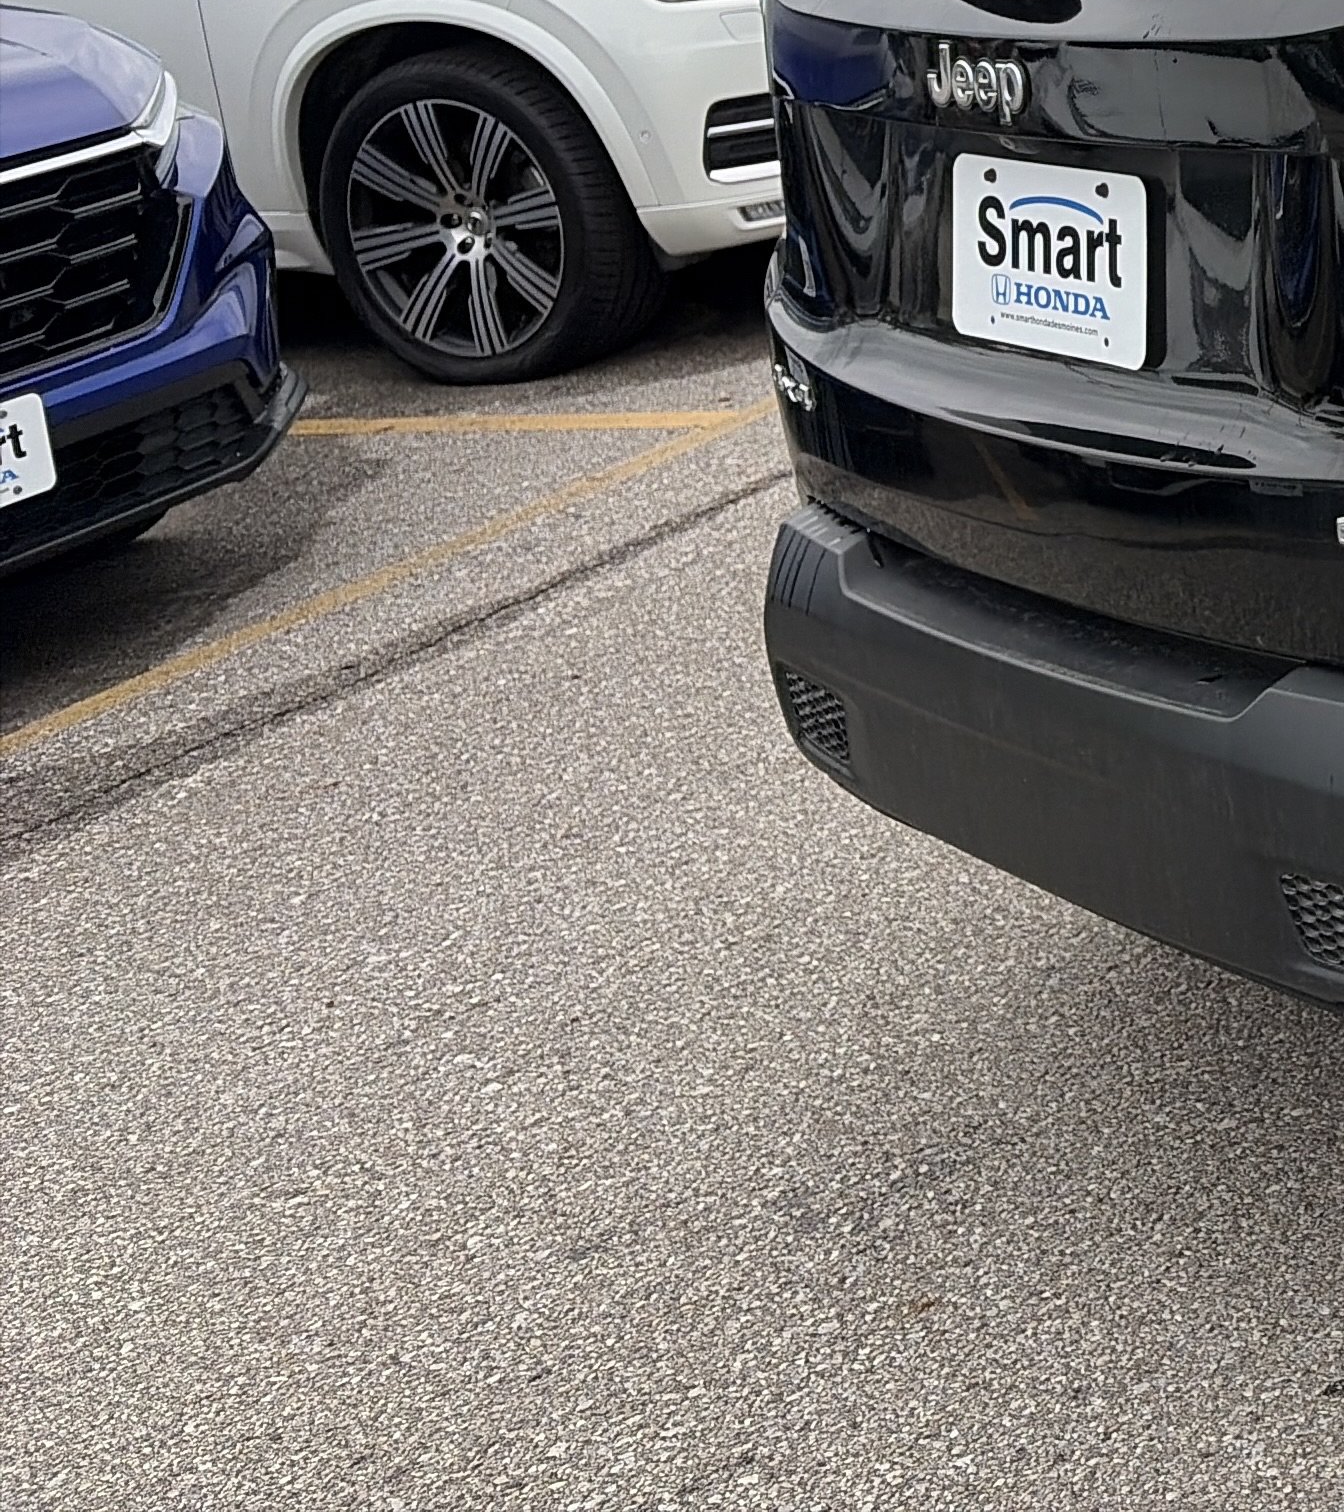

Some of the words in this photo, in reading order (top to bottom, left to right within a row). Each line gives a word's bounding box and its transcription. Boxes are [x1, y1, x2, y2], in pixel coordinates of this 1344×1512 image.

[926, 40, 1025, 126] Jeep
[977, 195, 1122, 288] Smart
[1000, 311, 1099, 337] www.smarthondadesmoines.com
[1014, 282, 1111, 321] HONDA
